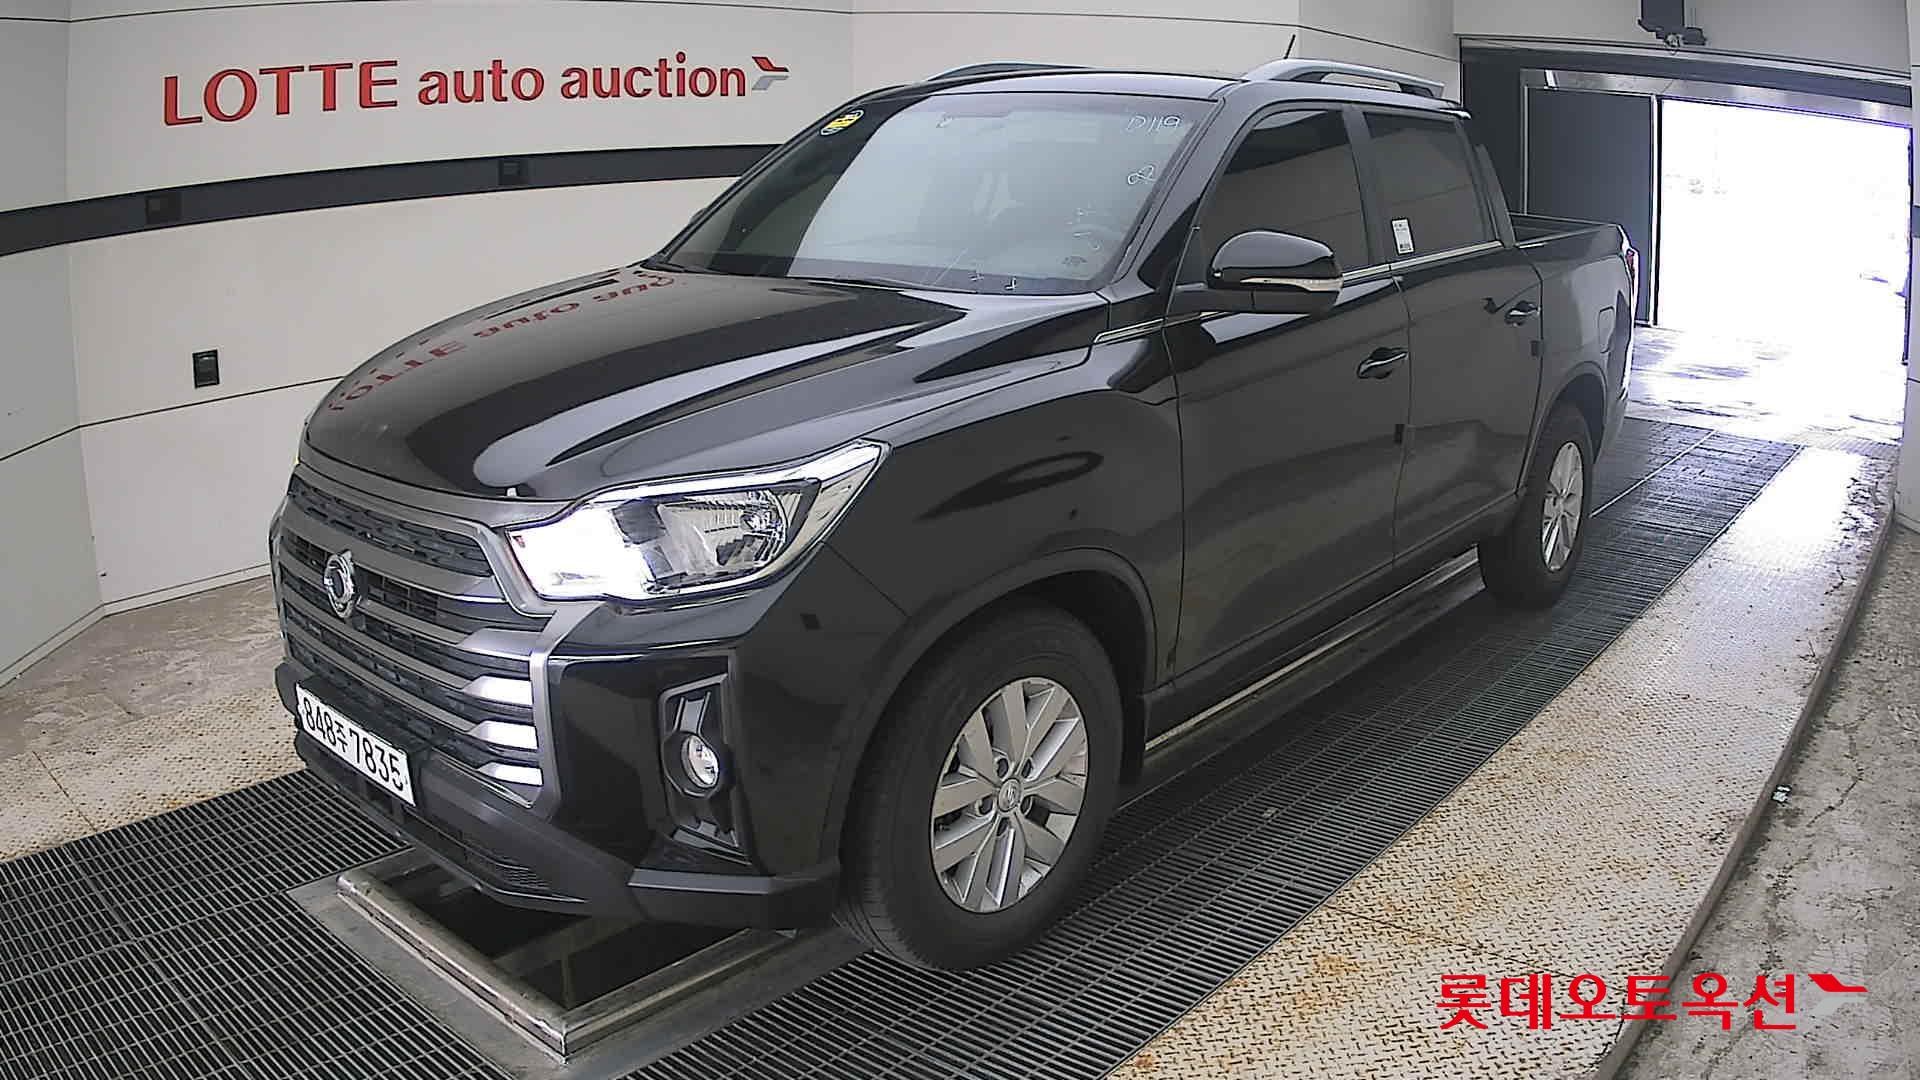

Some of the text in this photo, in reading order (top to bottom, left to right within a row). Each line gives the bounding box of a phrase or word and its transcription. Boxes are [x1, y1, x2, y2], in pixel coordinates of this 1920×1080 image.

[163, 51, 747, 126] LOTTE auto auction
